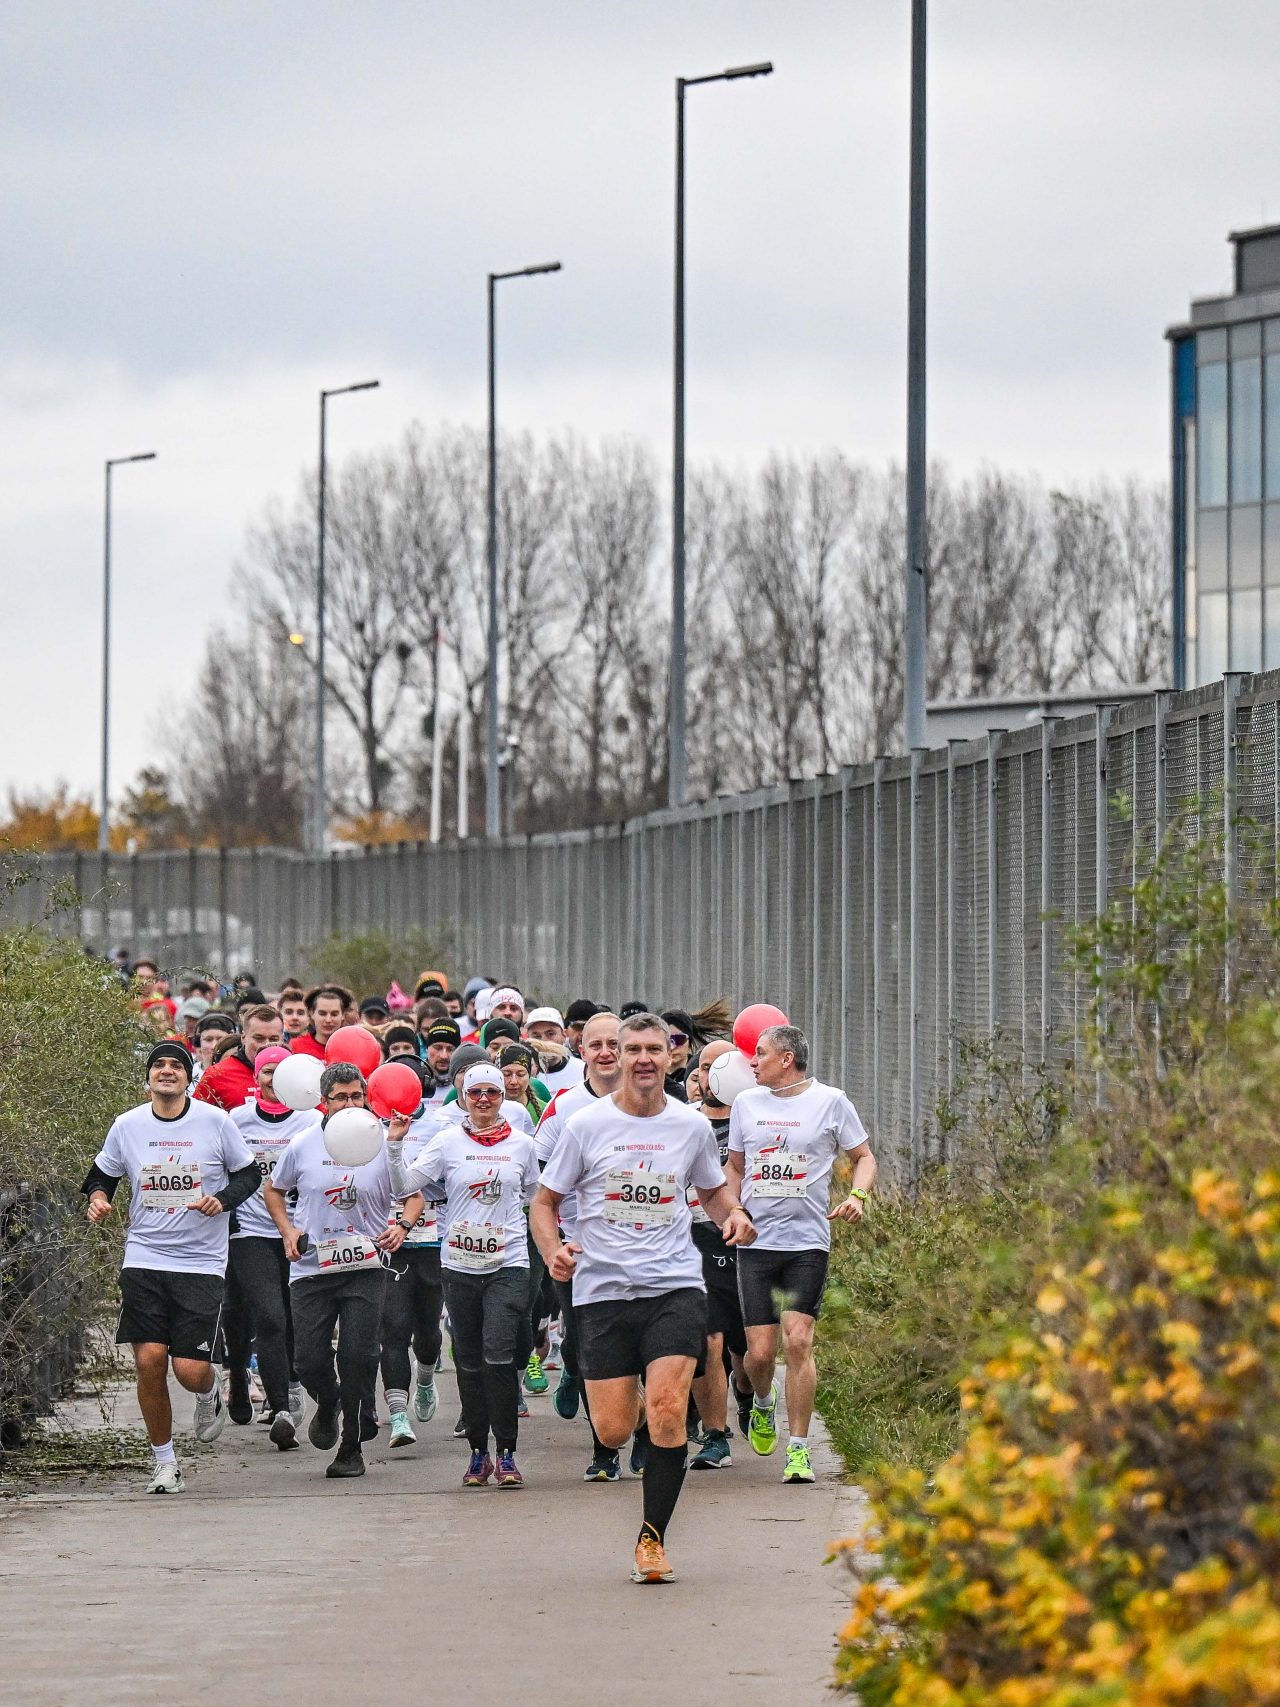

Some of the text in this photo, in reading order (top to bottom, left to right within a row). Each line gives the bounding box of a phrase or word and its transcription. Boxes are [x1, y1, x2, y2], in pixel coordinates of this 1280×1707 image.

[761, 1164, 794, 1180] 884
[148, 1175, 193, 1191] 1069
[620, 1183, 661, 1205] 369
[455, 1234, 498, 1253] 1016
[331, 1245, 365, 1264] 405
